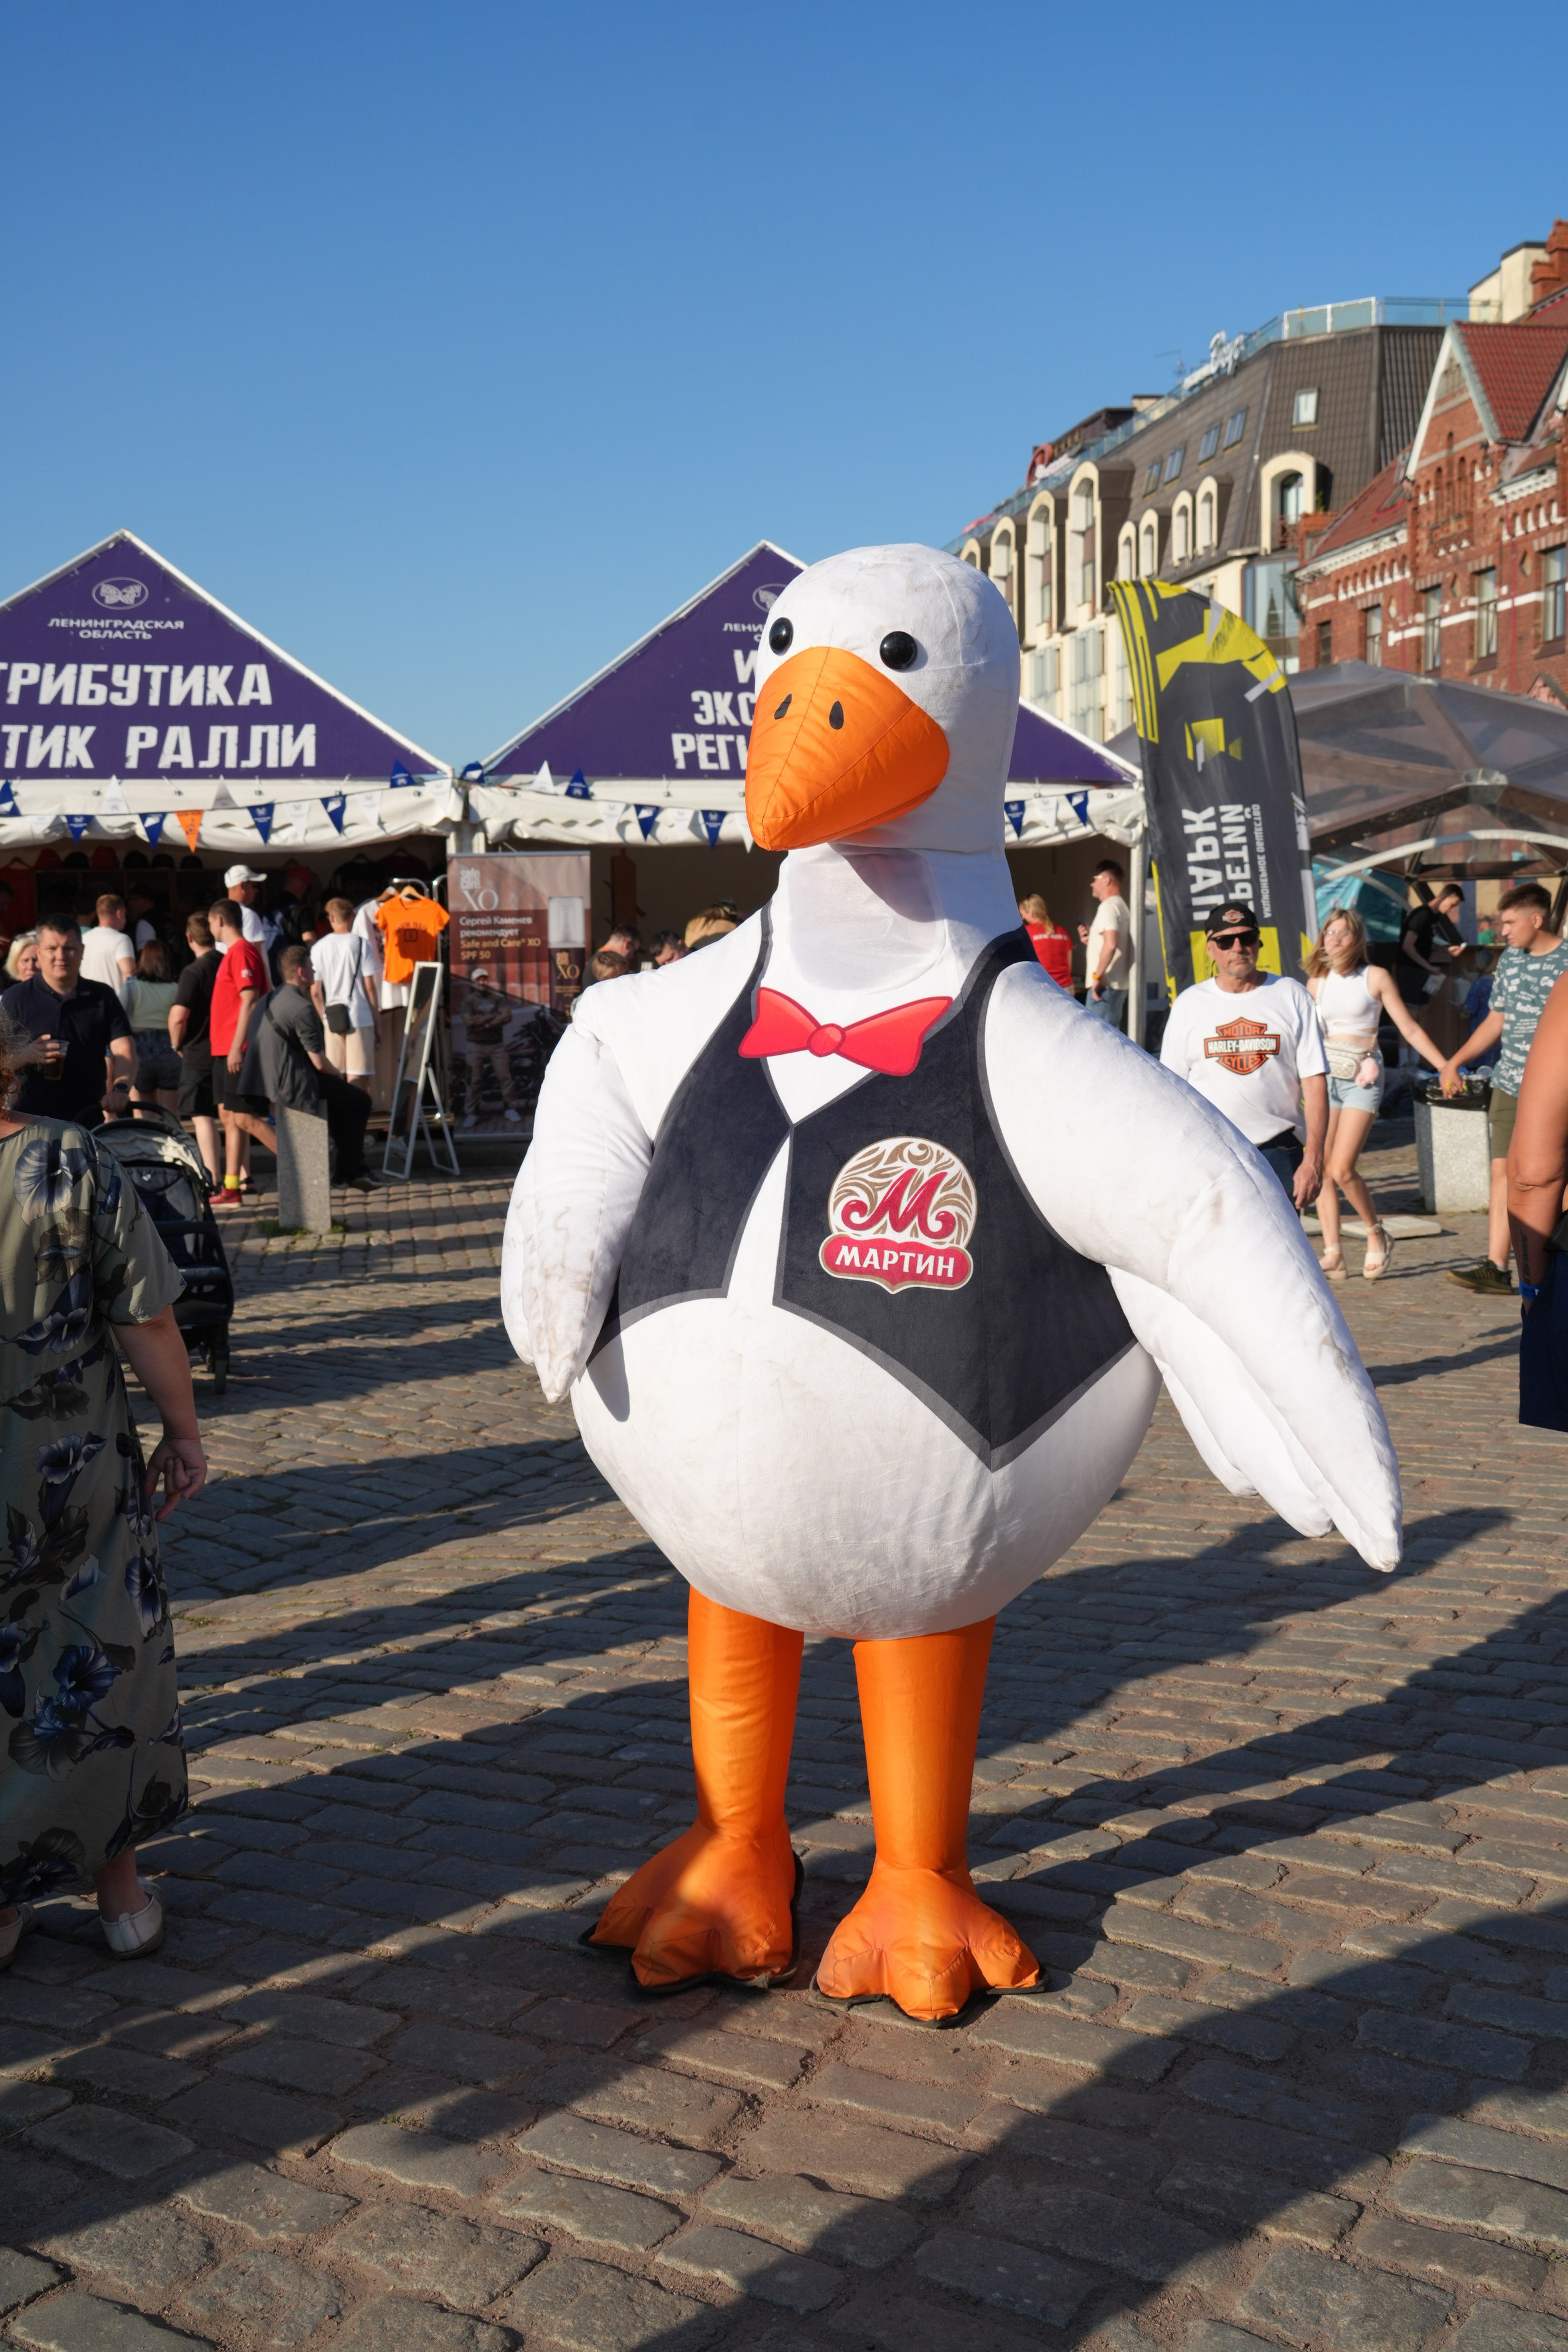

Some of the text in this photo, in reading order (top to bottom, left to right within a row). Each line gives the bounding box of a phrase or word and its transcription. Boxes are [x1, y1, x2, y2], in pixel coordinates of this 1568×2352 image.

[47, 618, 184, 630] ЛЕНИНГРАДСКАЯ
[723, 623, 765, 632] ЛЕНИ
[79, 630, 152, 639] ОБЛАСТЬ
[0, 662, 272, 706] РИБУТИКА
[124, 724, 316, 769] РАЛЛИ
[460, 888, 499, 911] XO
[461, 939, 480, 949] Safe
[481, 938, 499, 948] and
[527, 938, 541, 947] XO
[461, 951, 477, 960] SPF
[1224, 1022, 1261, 1036] MOTOR
[1208, 1038, 1276, 1054] HARLEY-DAVIDSON
[1224, 1055, 1261, 1071] CYCLES
[835, 1245, 956, 1278] МАРТИН
